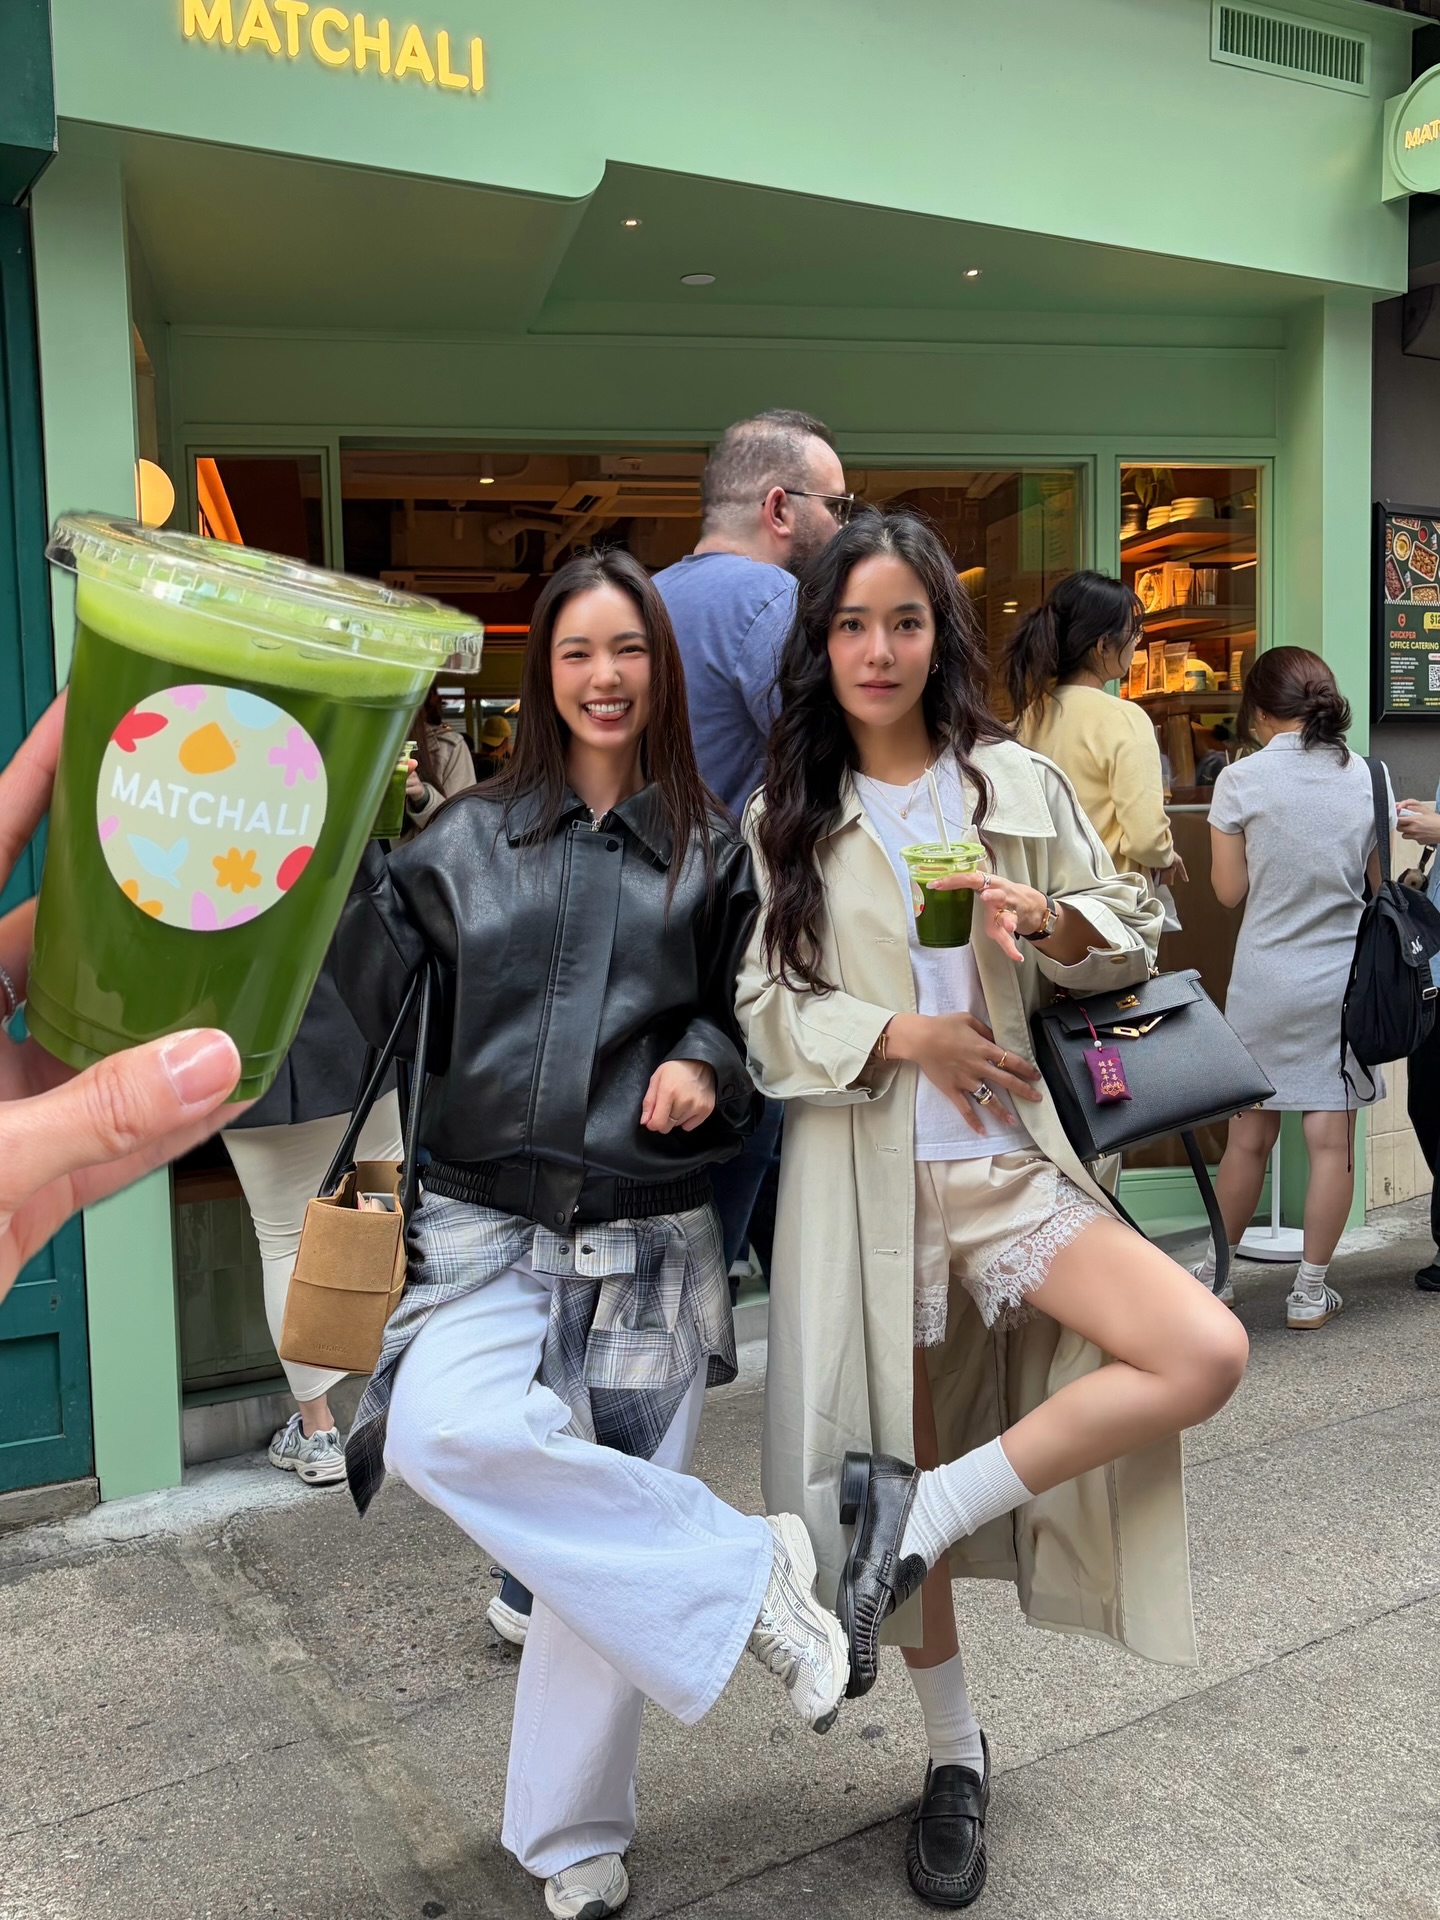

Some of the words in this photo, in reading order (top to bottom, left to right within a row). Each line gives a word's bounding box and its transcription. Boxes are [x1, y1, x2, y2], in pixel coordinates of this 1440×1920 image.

[183, 0, 485, 91] MATCHALI
[1389, 640, 1410, 649] OFFICE
[1410, 641, 1439, 650] CATERING
[110, 765, 311, 836] MATCHALI
